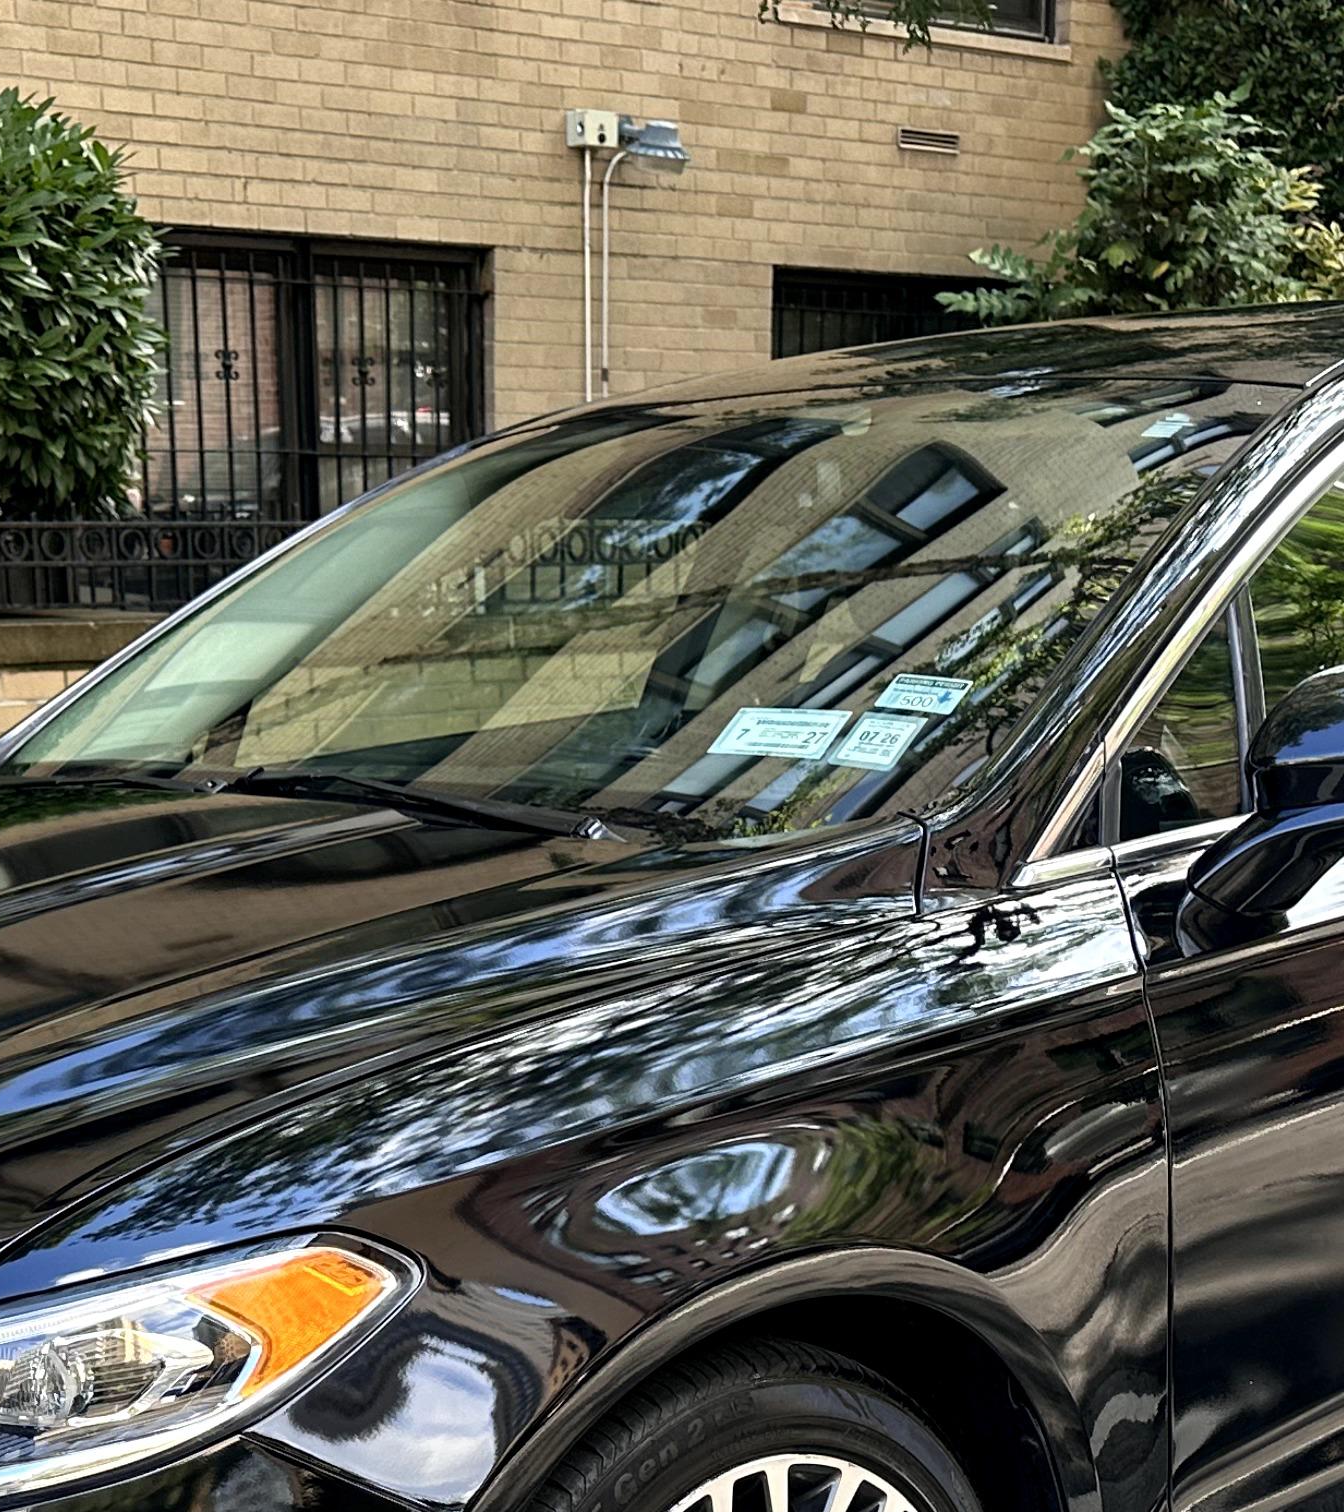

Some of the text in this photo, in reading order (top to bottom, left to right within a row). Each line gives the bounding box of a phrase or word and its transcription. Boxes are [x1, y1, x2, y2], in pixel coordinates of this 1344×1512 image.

[900, 695, 934, 708] 500
[735, 728, 751, 741] 7
[802, 731, 830, 745] 27
[858, 730, 880, 742] 07
[880, 732, 901, 745] 26
[612, 1440, 679, 1504] Gen
[686, 1416, 705, 1447] 2
